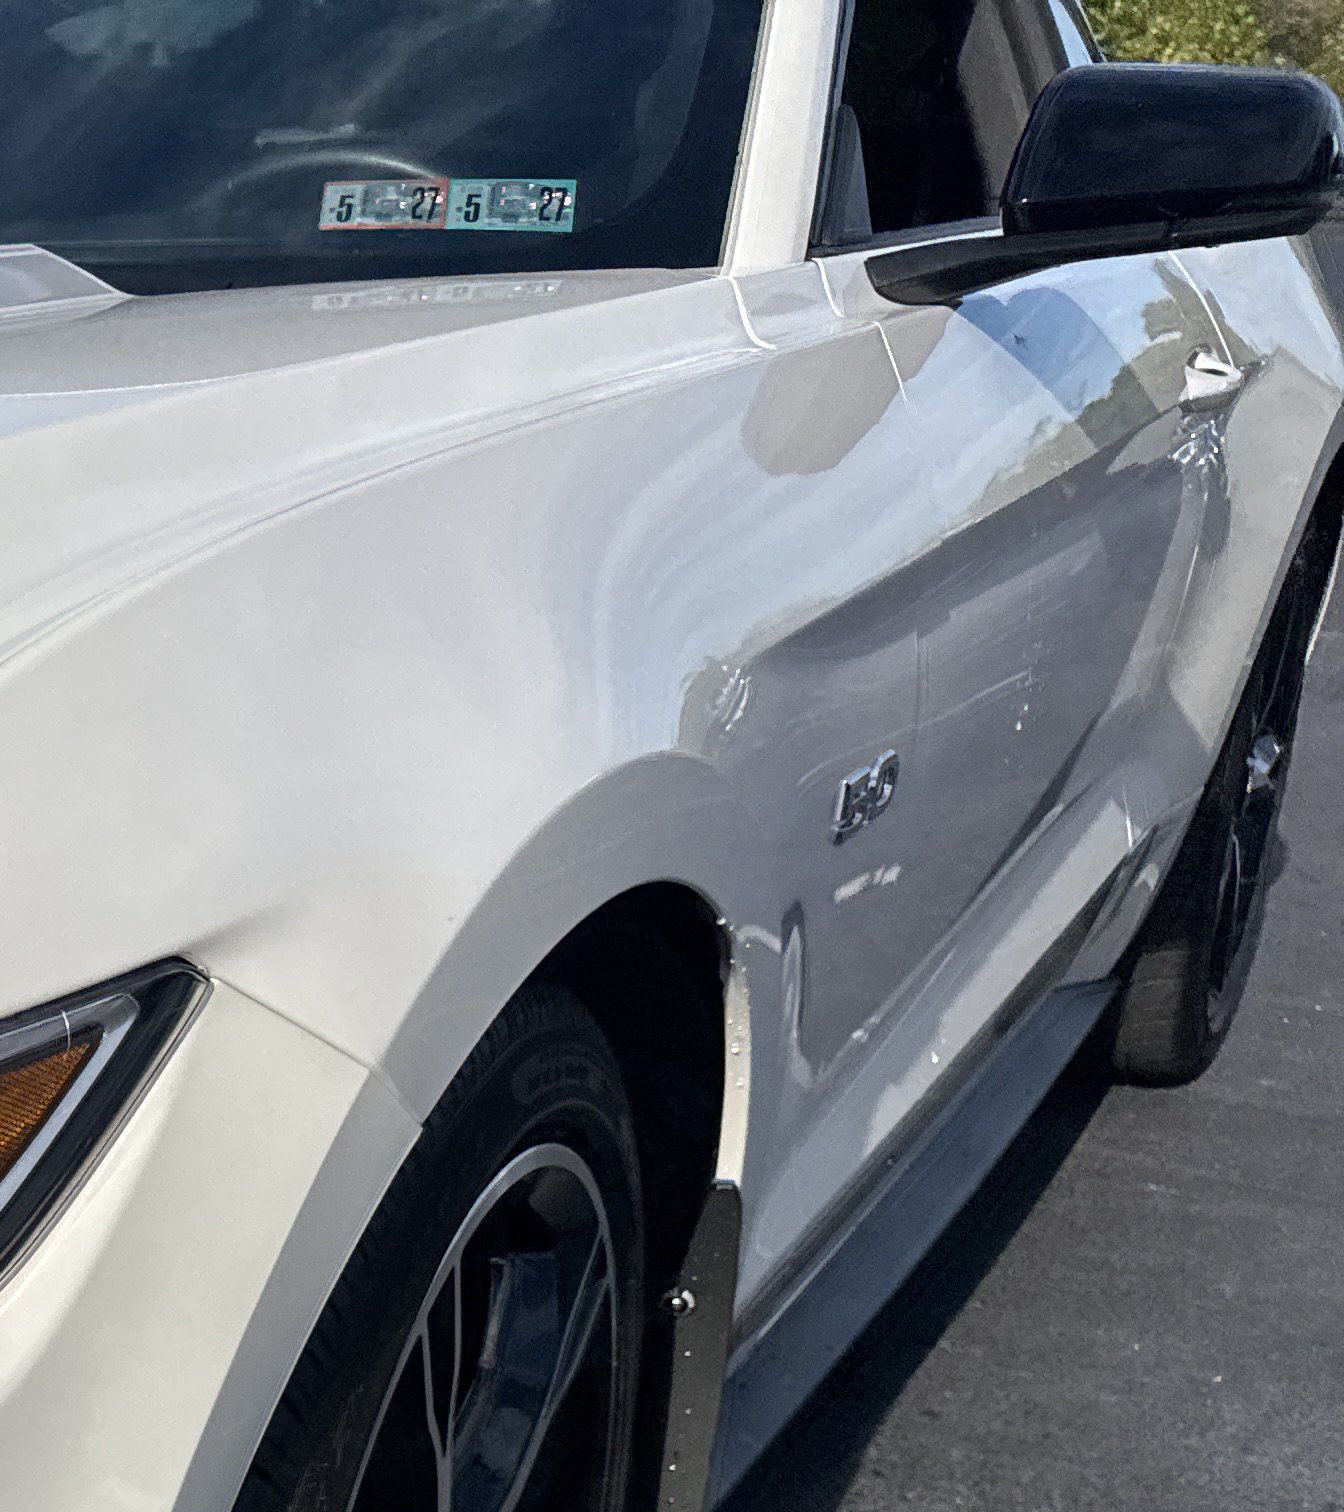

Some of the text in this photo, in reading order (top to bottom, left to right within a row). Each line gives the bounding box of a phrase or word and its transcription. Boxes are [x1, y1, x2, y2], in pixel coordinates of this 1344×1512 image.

[336, 186, 441, 222] 5 27
[464, 186, 568, 222] 5 27
